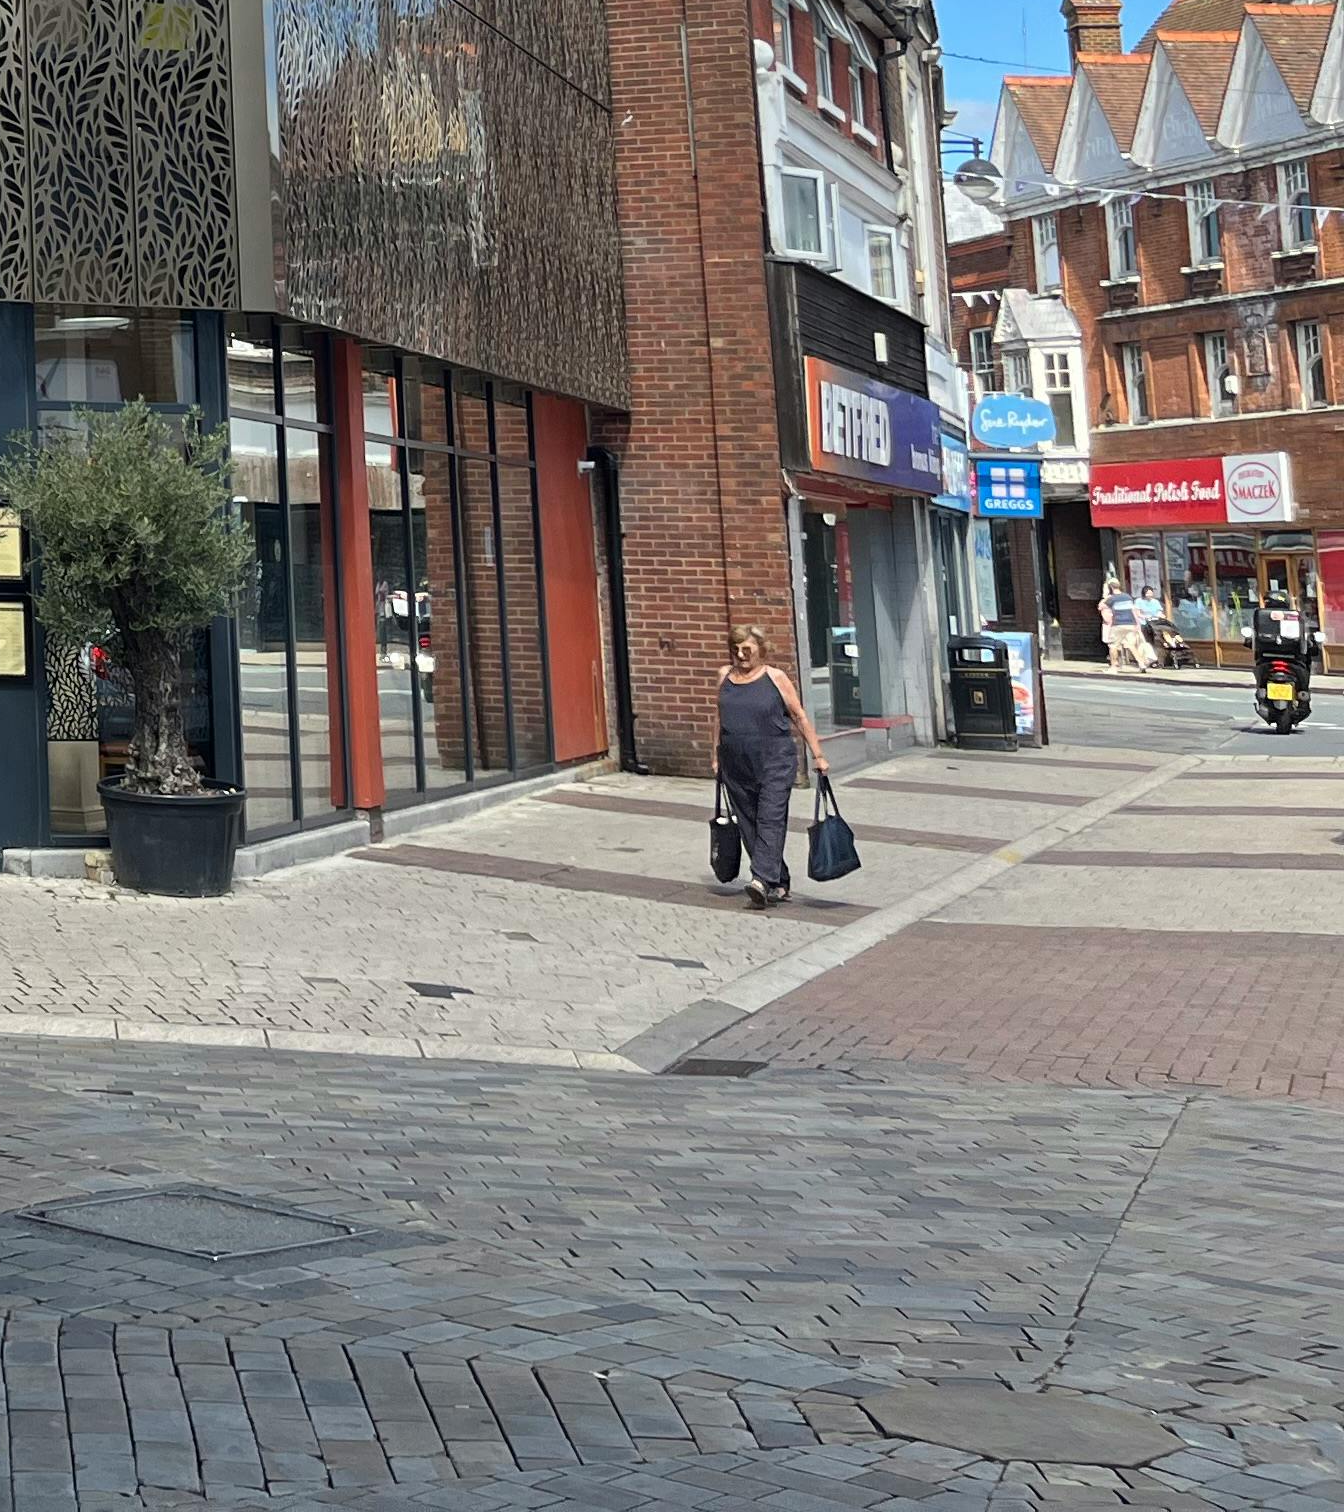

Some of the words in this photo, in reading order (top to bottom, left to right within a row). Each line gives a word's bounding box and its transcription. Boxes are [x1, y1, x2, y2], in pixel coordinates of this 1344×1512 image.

[820, 380, 891, 467] BETFRED
[984, 497, 1035, 511] GREGGS
[1092, 482, 1152, 506] Traditional
[1153, 478, 1189, 503] Polish
[1191, 479, 1221, 501] Food
